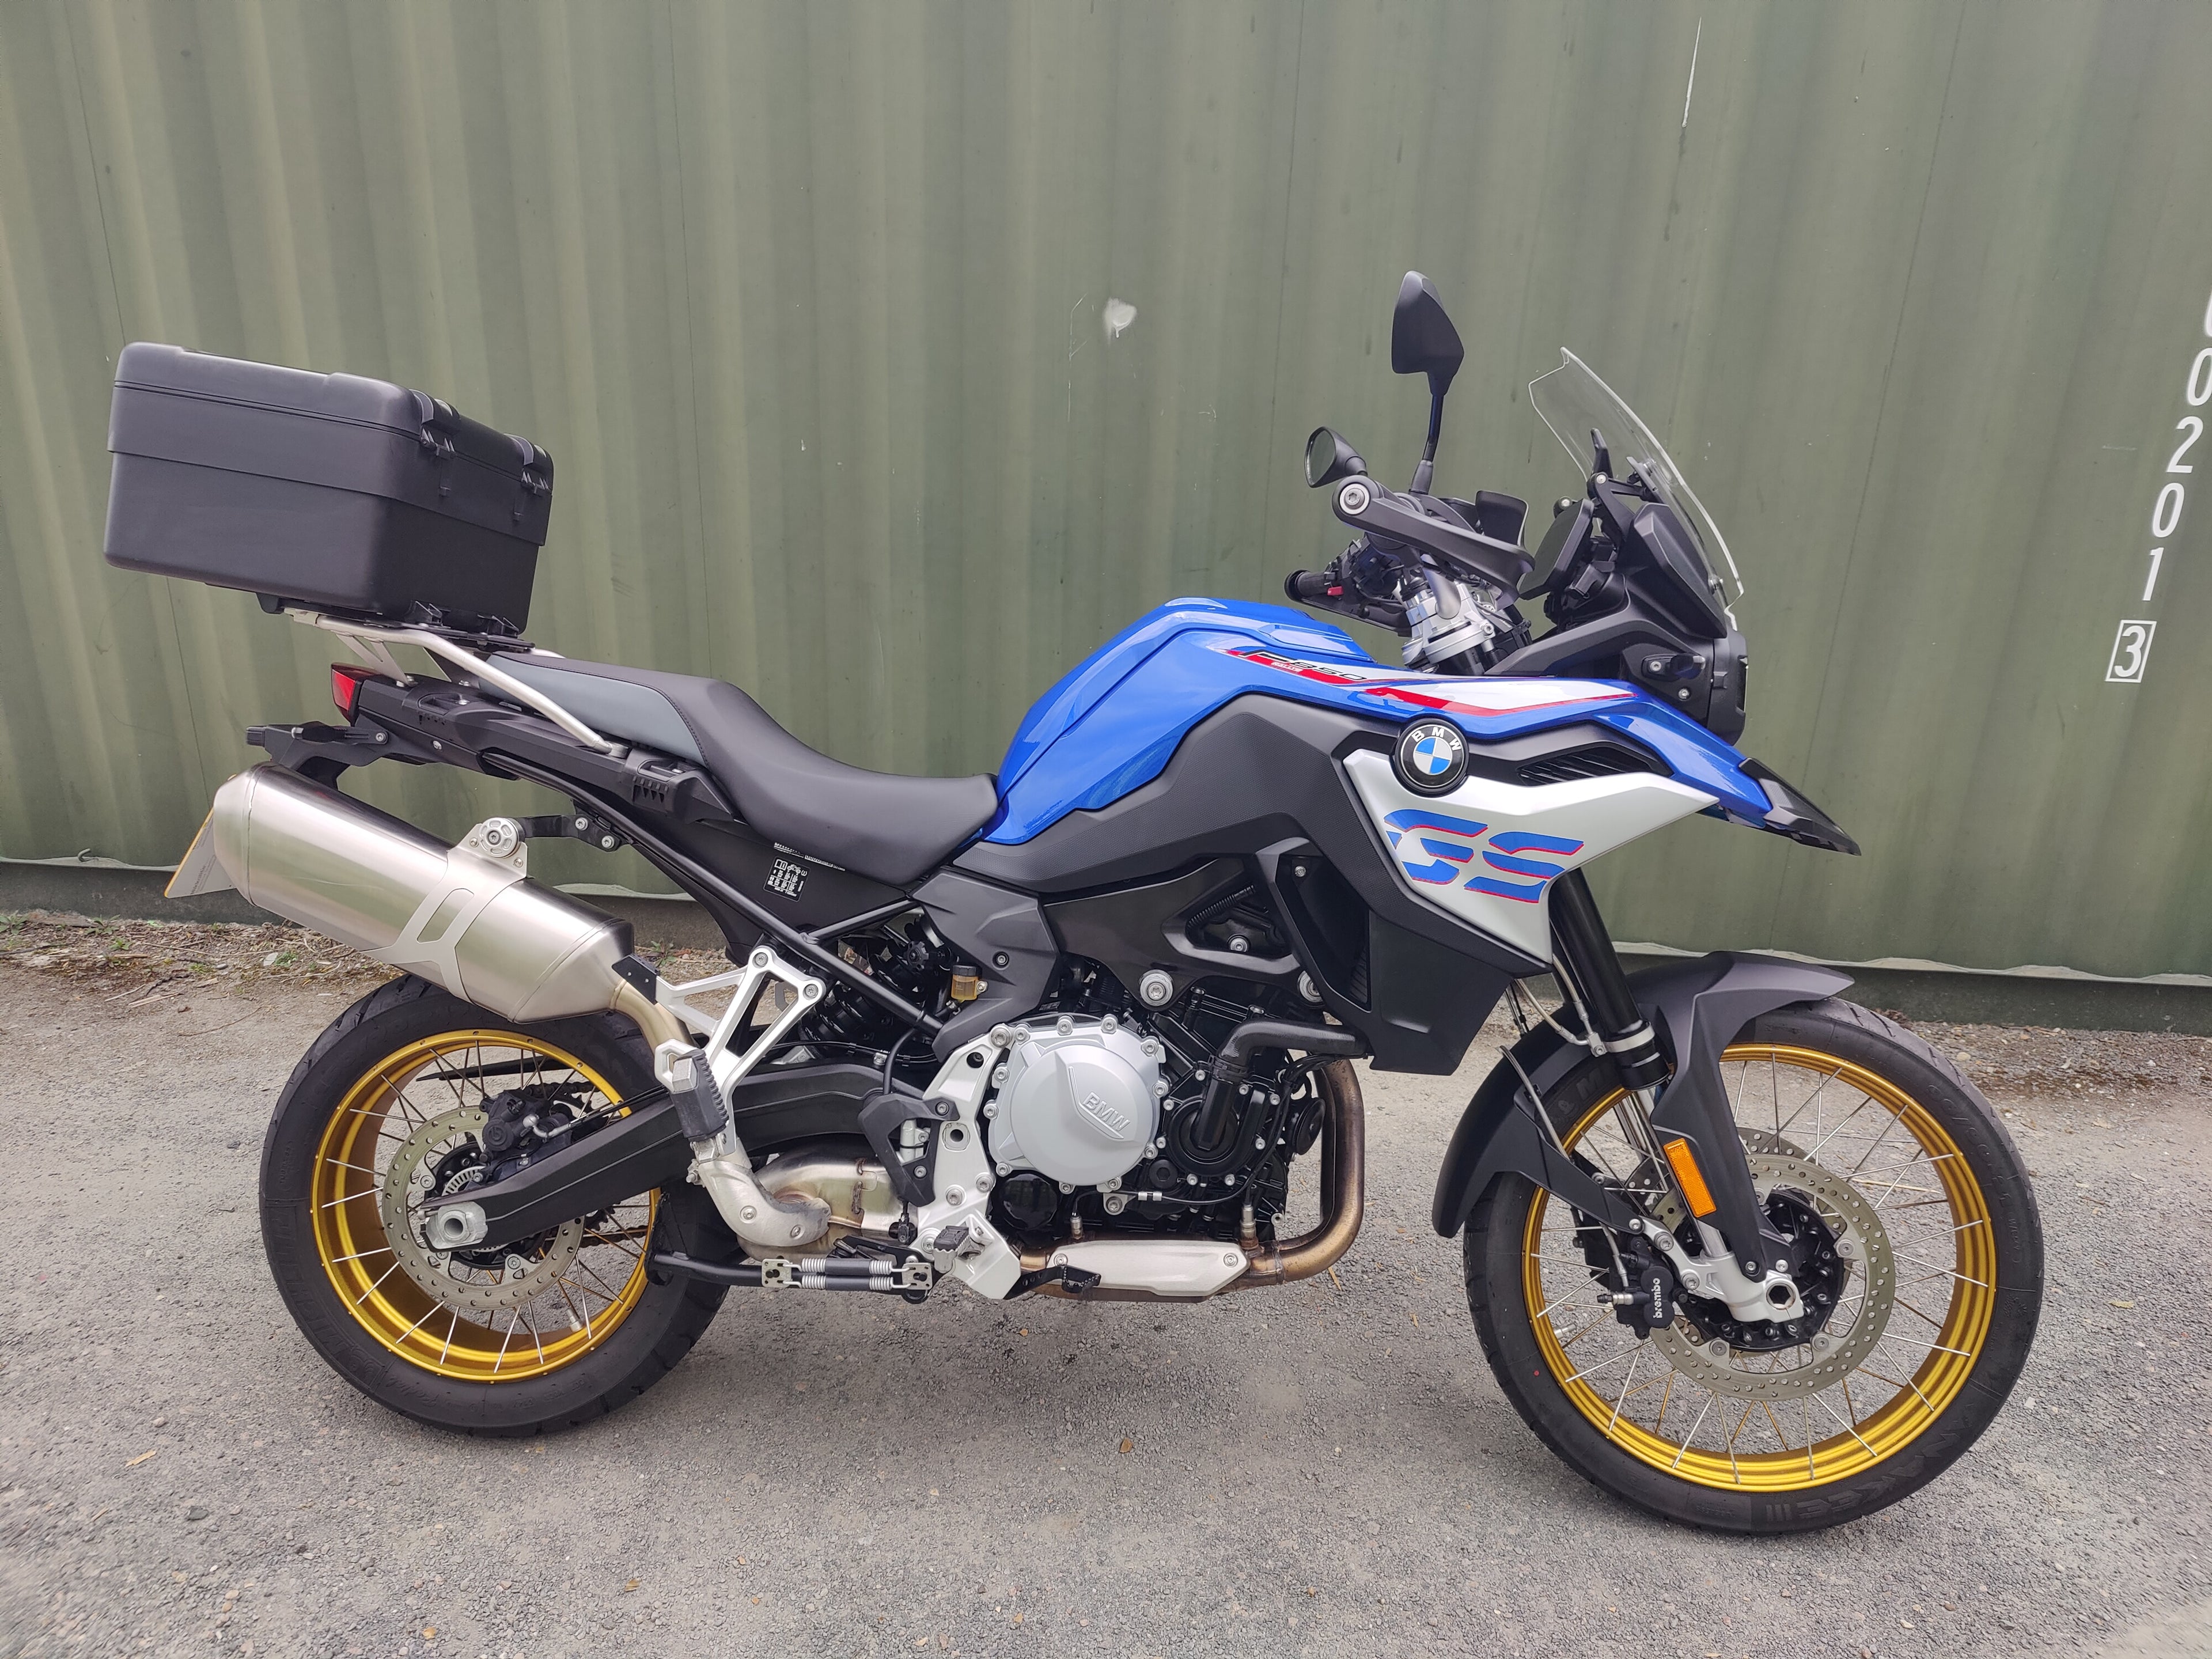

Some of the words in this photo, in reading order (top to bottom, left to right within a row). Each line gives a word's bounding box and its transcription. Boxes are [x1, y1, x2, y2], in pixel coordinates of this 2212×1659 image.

[2141, 283, 2212, 602] 0201
[1411, 726, 1461, 751] BMW
[1383, 809, 1585, 904] GS
[1082, 1091, 1131, 1132] BMW
[1651, 1277, 1663, 1319] brembo
